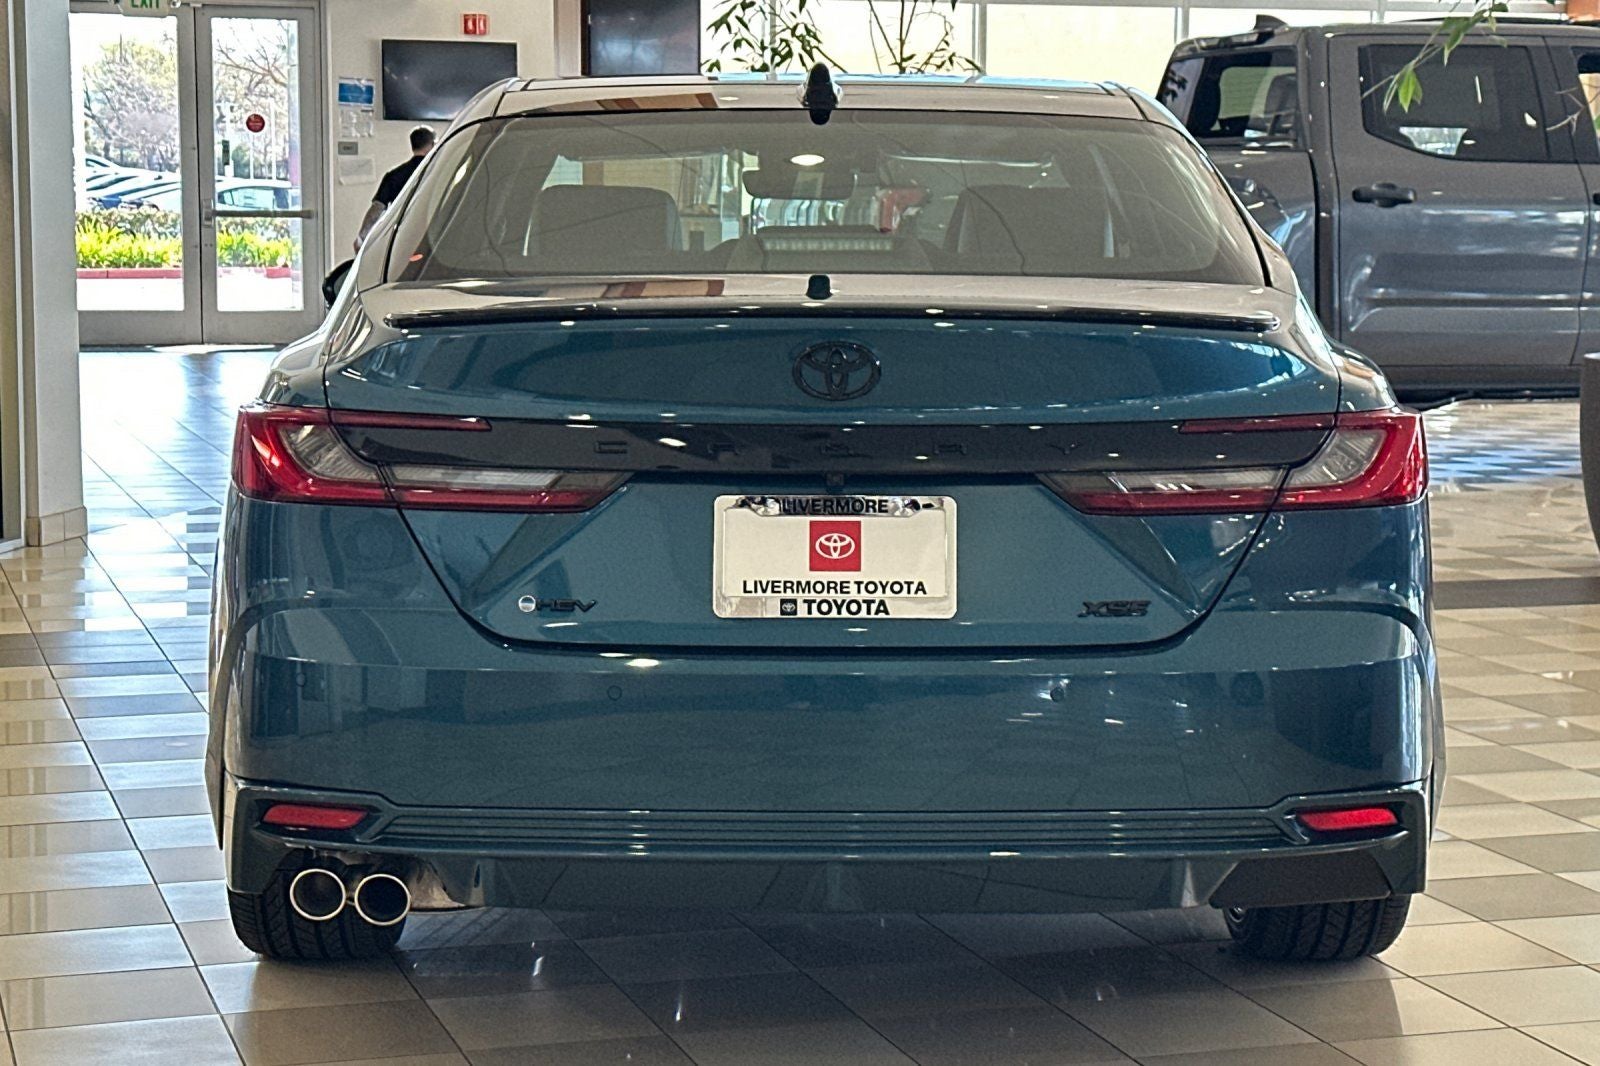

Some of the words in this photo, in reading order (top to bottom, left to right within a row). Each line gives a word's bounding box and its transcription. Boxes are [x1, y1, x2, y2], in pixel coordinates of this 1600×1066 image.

[131, 0, 160, 8] EXIT
[782, 499, 889, 514] LIVERMORE
[743, 580, 850, 595] LIVERMORE
[854, 581, 927, 595] TOYOTA
[803, 599, 890, 616] TOYOTA
